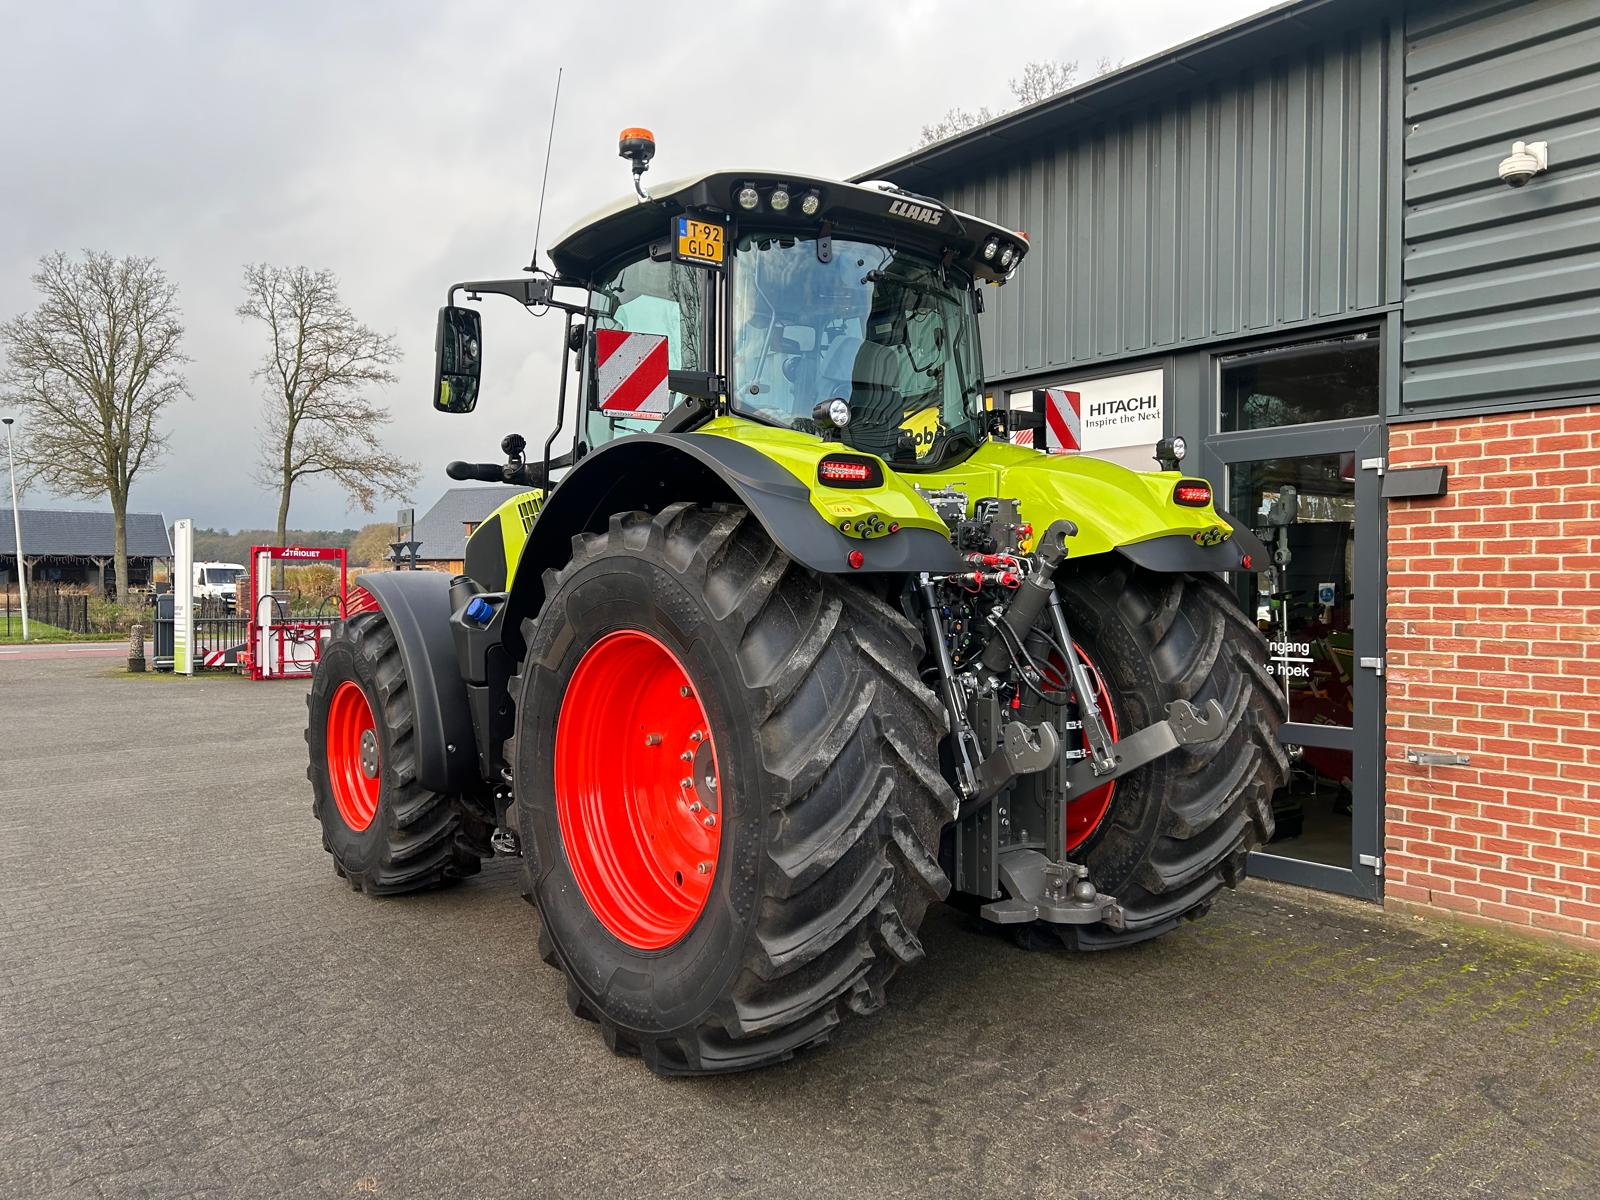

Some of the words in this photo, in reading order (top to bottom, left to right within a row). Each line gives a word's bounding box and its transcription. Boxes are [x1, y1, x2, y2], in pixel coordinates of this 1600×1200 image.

[889, 200, 943, 225] CLAAS
[690, 222, 720, 242] T-92
[688, 240, 715, 257] GLD
[1089, 395, 1157, 417] HITACHI
[1085, 417, 1118, 428] Inspire
[1120, 414, 1136, 424] the
[1138, 409, 1161, 422] Next
[290, 550, 320, 558] TRIOLIET
[1266, 639, 1310, 656] ngang
[1263, 663, 1275, 675] e
[1278, 663, 1310, 677] hoek
